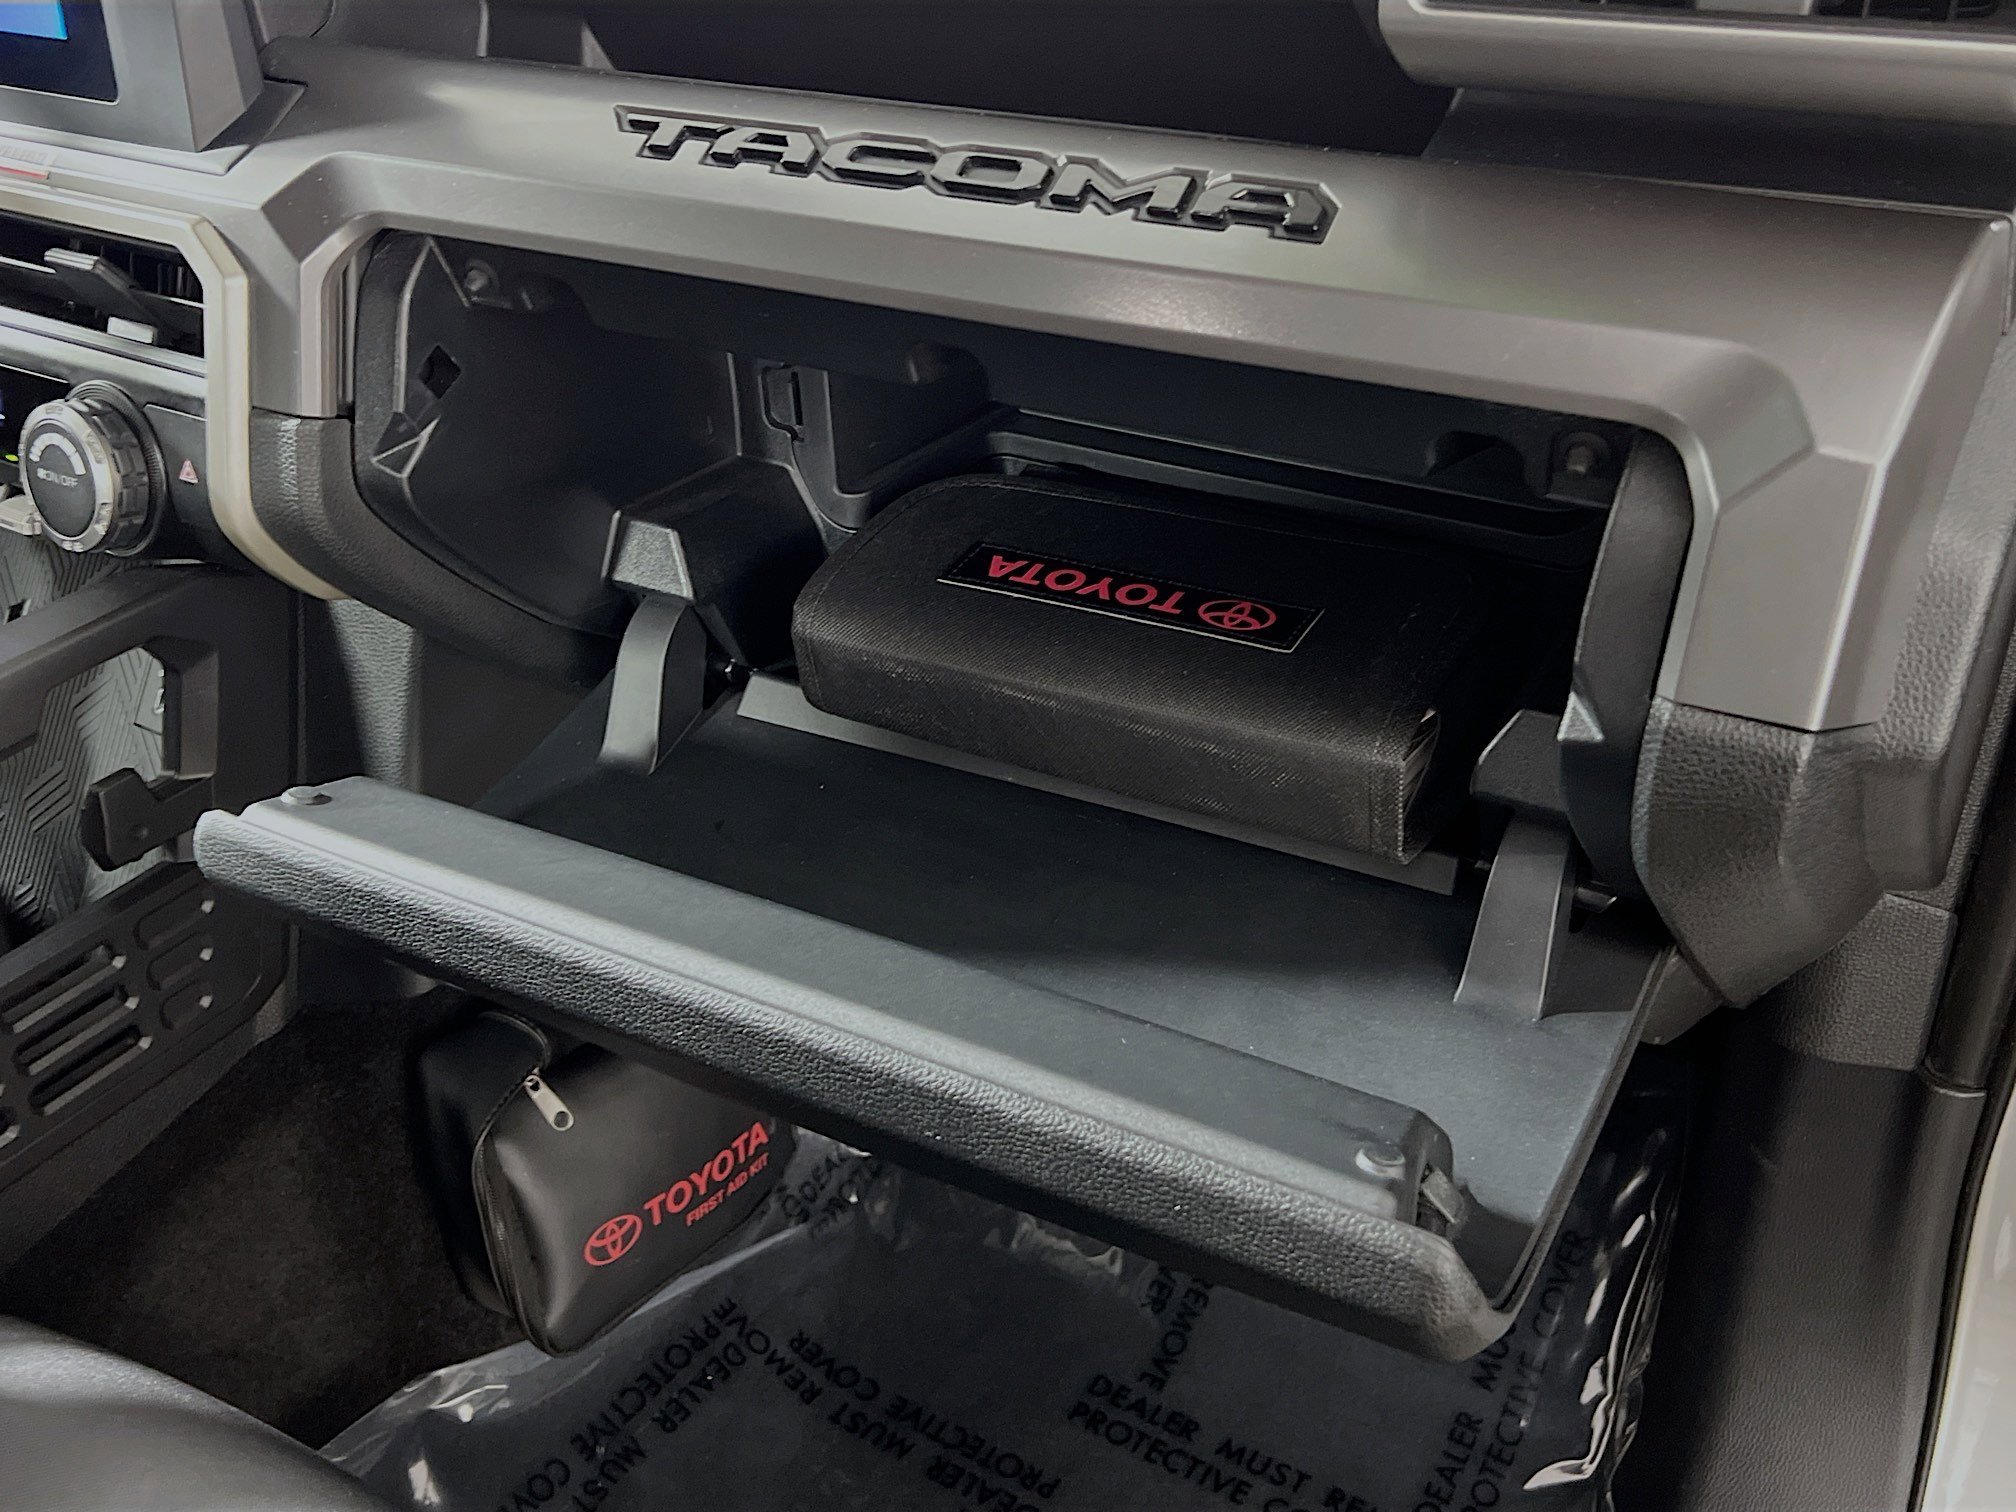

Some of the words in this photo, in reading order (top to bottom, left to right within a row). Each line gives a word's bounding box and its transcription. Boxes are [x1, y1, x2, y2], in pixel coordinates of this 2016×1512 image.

[614, 106, 1342, 243] TACOMA
[988, 554, 1185, 615] TOYOTA
[642, 1120, 770, 1226] TOYOTA
[685, 1188, 726, 1227] FIRST
[726, 1171, 749, 1196] AID
[748, 1152, 770, 1177] KIT
[570, 1314, 721, 1462] PROTECTIVE
[652, 1342, 746, 1433] DEALER
[713, 1297, 823, 1405] REMOVE
[788, 1329, 881, 1402] COVER
[827, 1402, 915, 1460] MUST
[885, 1394, 1062, 1499] PROTECTIVE
[1067, 1401, 1254, 1505] PROTECTIVE
[1087, 1374, 1200, 1442] DEALER
[1215, 1437, 1314, 1494] MUST
